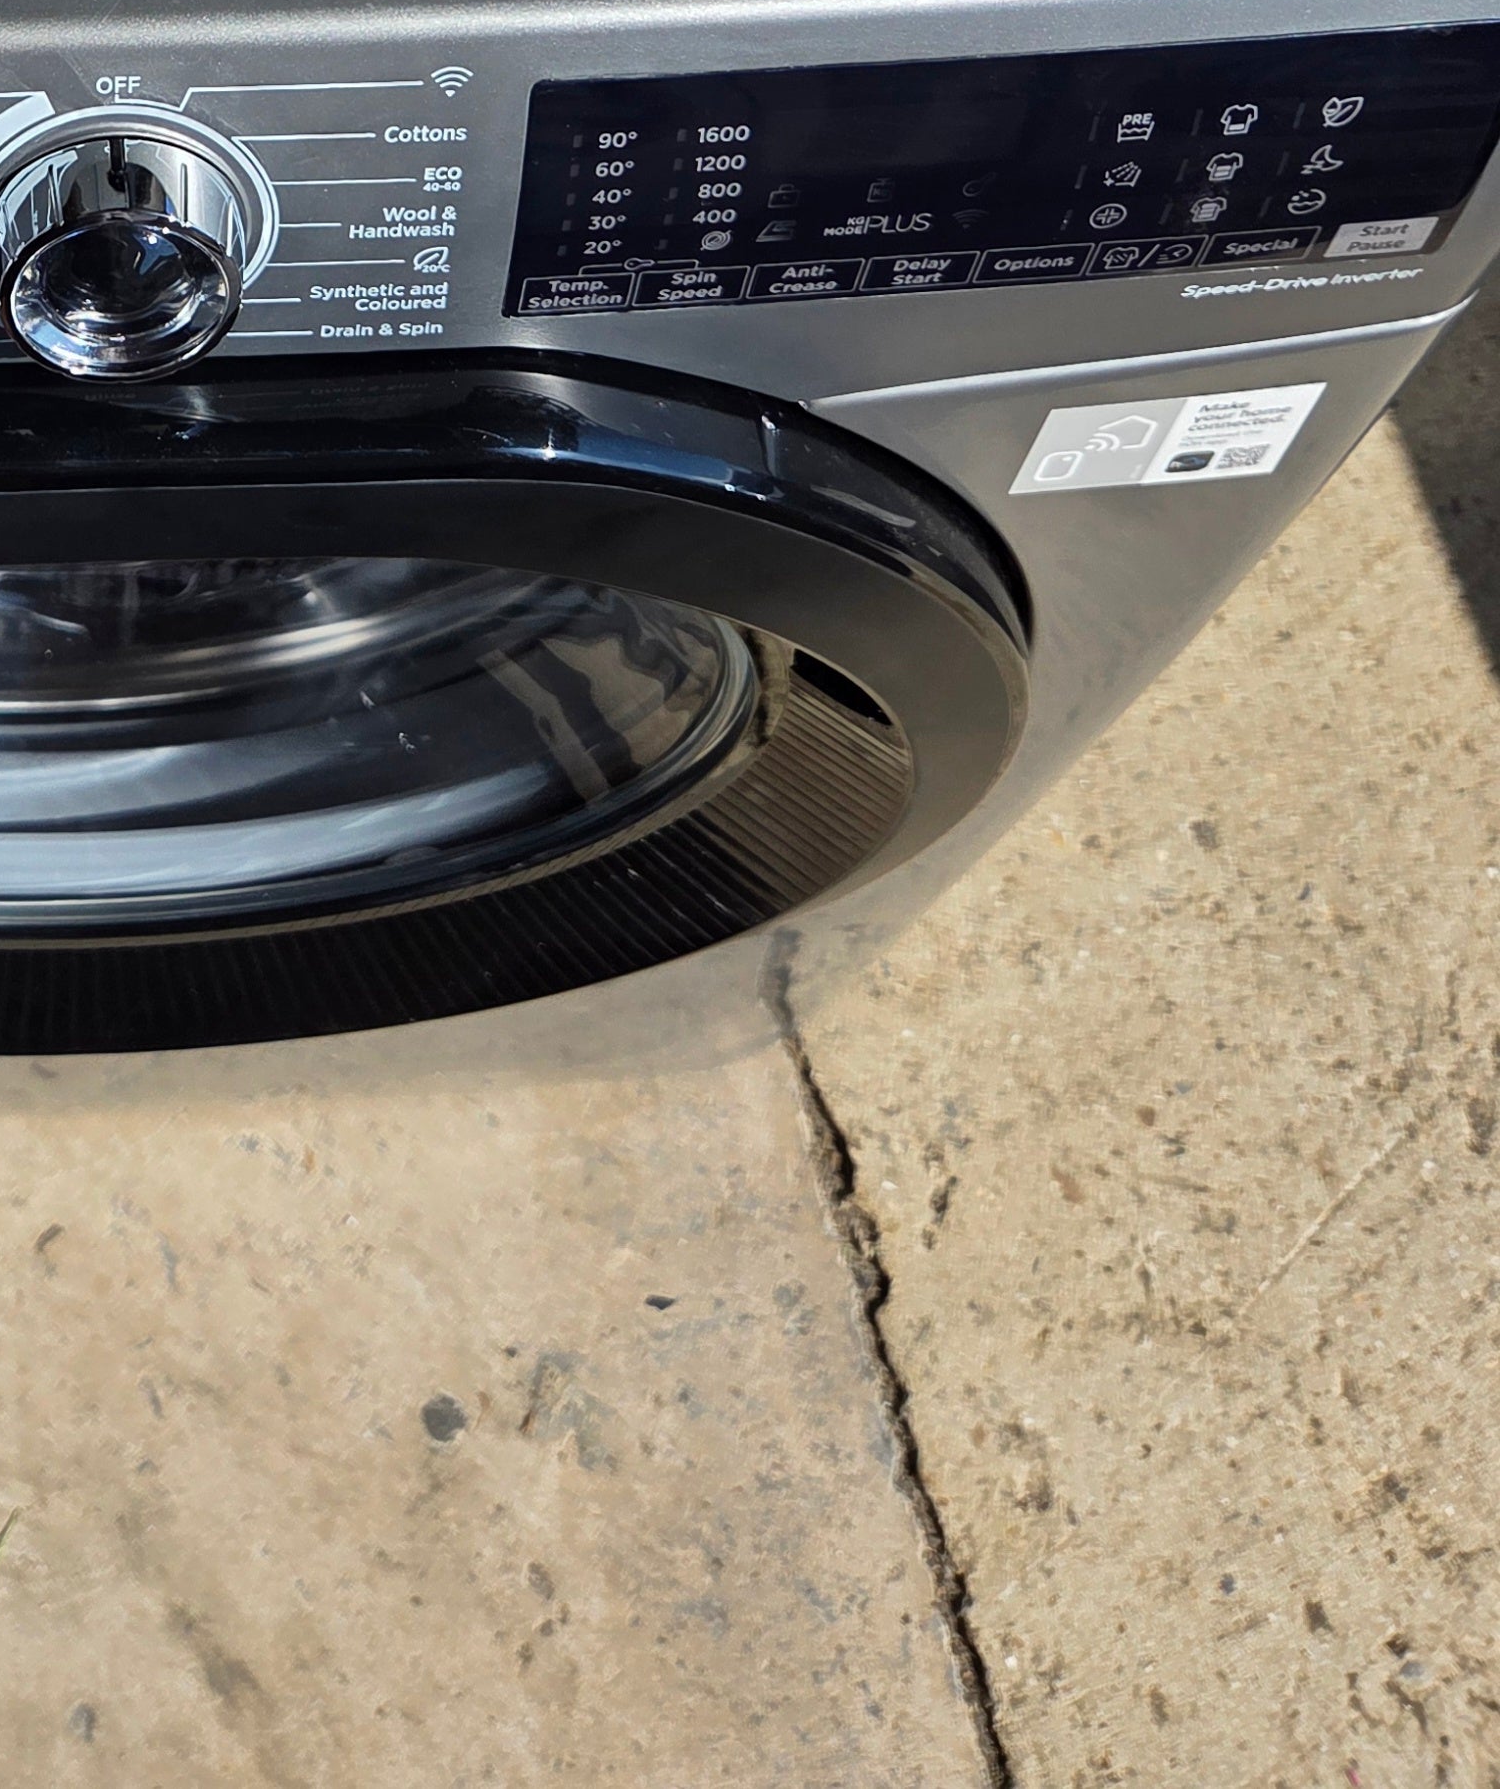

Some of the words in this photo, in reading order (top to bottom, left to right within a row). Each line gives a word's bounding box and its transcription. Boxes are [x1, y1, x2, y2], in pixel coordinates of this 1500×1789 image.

[95, 76, 141, 94] OFF
[1122, 113, 1152, 126] PRE
[384, 125, 467, 143] Cottons
[599, 131, 638, 149] 90°
[698, 126, 750, 143] 1600
[595, 160, 635, 177] 60°
[695, 155, 746, 172] 1200
[423, 167, 462, 181] ECO
[423, 182, 461, 192] 40-60
[698, 183, 742, 198] 800
[592, 188, 632, 204] 40°
[383, 206, 436, 222] Wool
[441, 205, 457, 220] &
[692, 209, 737, 224] 400
[847, 217, 865, 225] KG
[349, 223, 455, 239] Handwash
[588, 215, 627, 231] 30°
[824, 225, 863, 236] MODE
[865, 213, 932, 234] PLUS
[1360, 224, 1409, 237] Start
[583, 240, 622, 255] 20°
[1223, 238, 1298, 254] Special
[1347, 238, 1405, 252] Pause
[782, 264, 834, 280] Anti-
[894, 259, 951, 272] Delay
[994, 256, 1075, 272] Options
[671, 270, 716, 286] Spin
[891, 272, 942, 286] Start
[1180, 276, 1329, 299] Speed-Drive
[1330, 268, 1424, 286] Inverter
[310, 283, 404, 301] Synthetic
[410, 282, 448, 296] and
[549, 279, 610, 294] Temp.
[657, 285, 722, 302] Speed
[769, 280, 838, 294] Crease
[355, 296, 447, 311] Coloured
[528, 293, 622, 310] Selection
[320, 322, 374, 337] Drain
[379, 323, 393, 336] &
[398, 321, 443, 336] Spin
